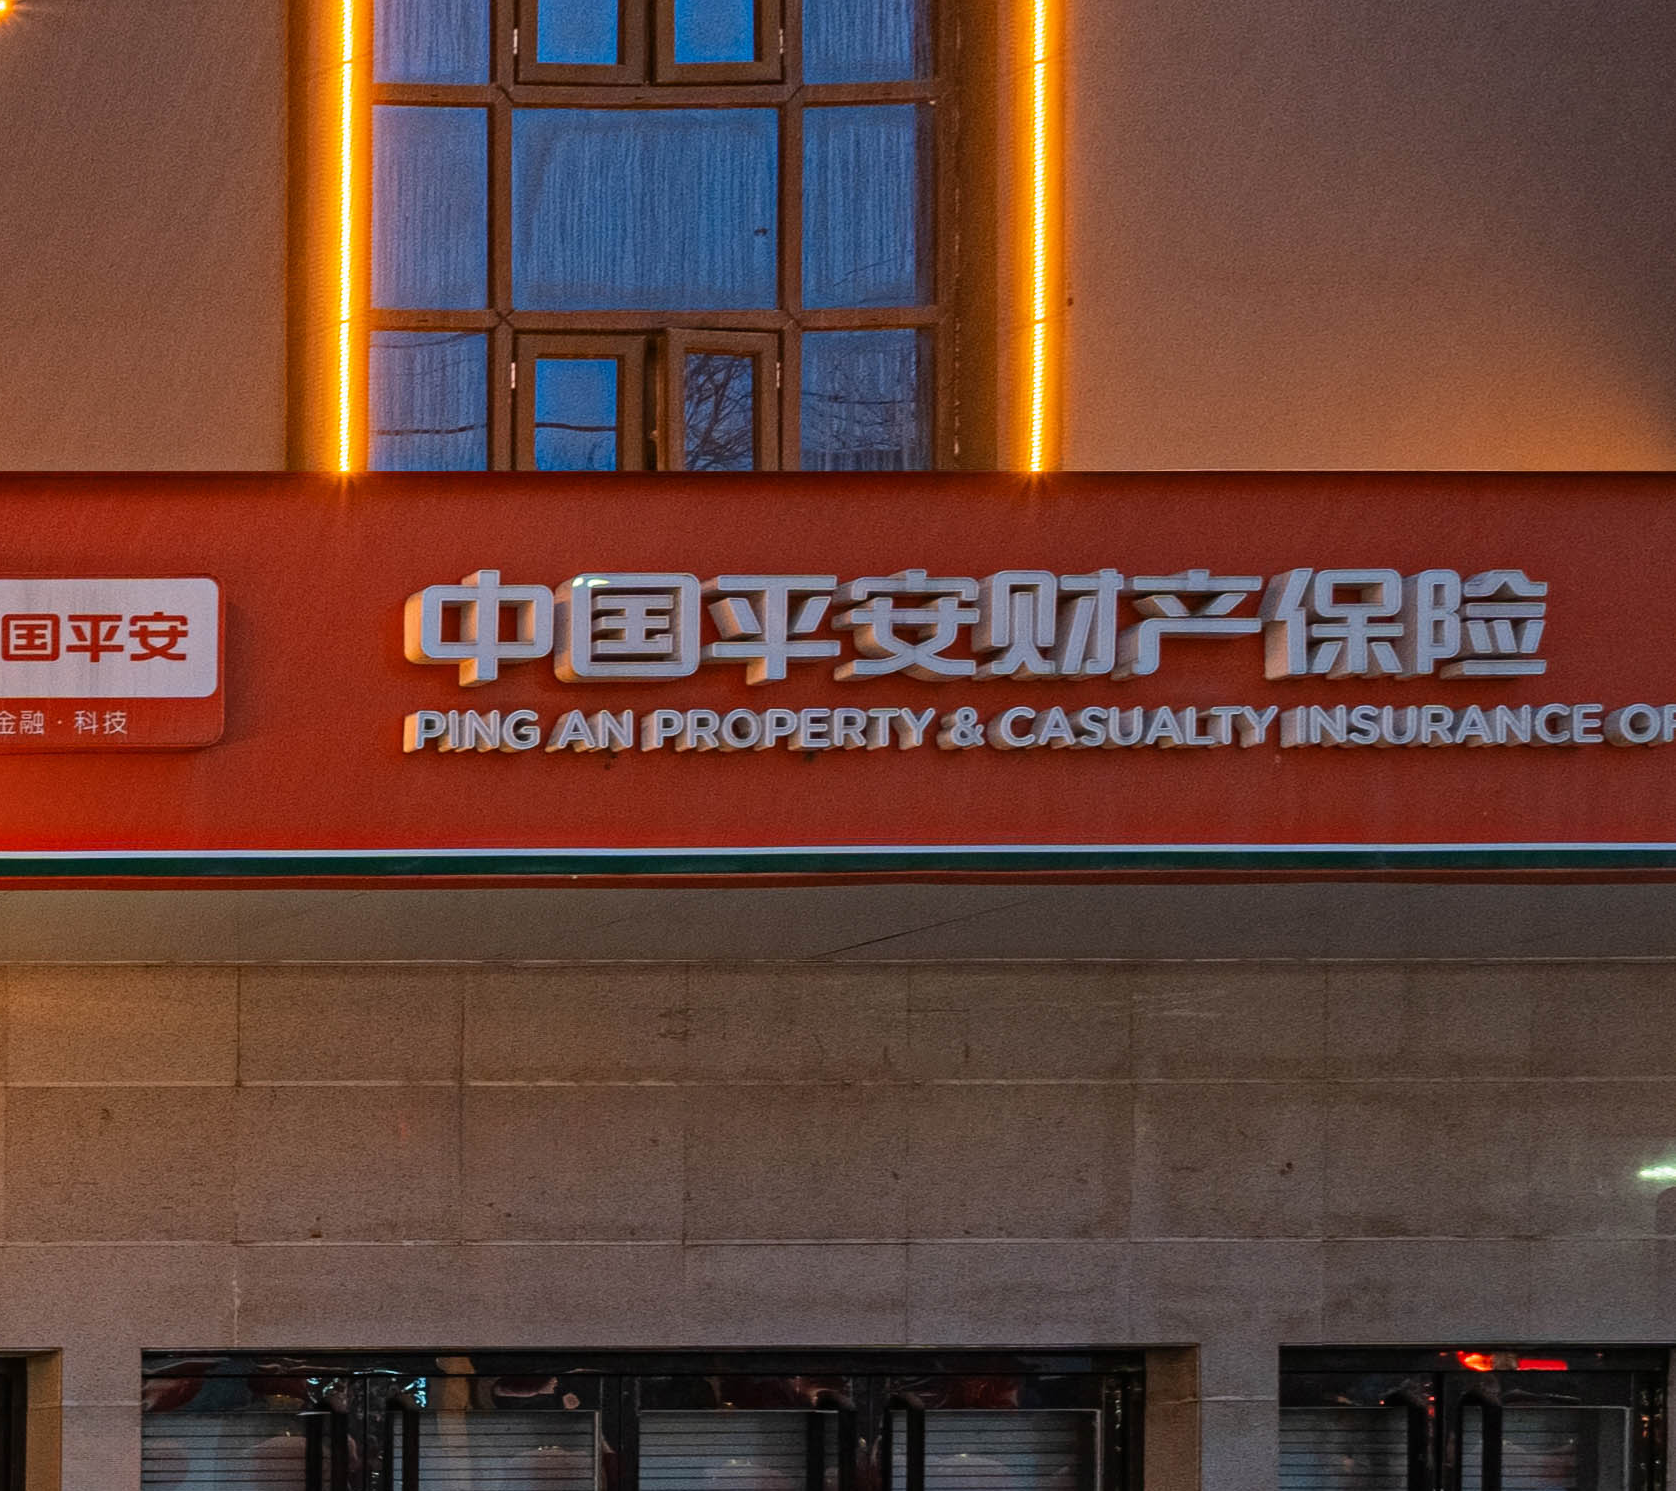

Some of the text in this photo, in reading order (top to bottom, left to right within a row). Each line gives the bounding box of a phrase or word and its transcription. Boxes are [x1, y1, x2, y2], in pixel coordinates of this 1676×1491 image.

[404, 568, 1548, 687] 中国平安财产保险
[408, 708, 541, 751] PING
[550, 708, 634, 751] AN
[647, 707, 936, 750] PROPERTY
[948, 706, 985, 749] &
[995, 705, 1279, 749] CASUALTY
[1290, 703, 1605, 748] INSURANCE
